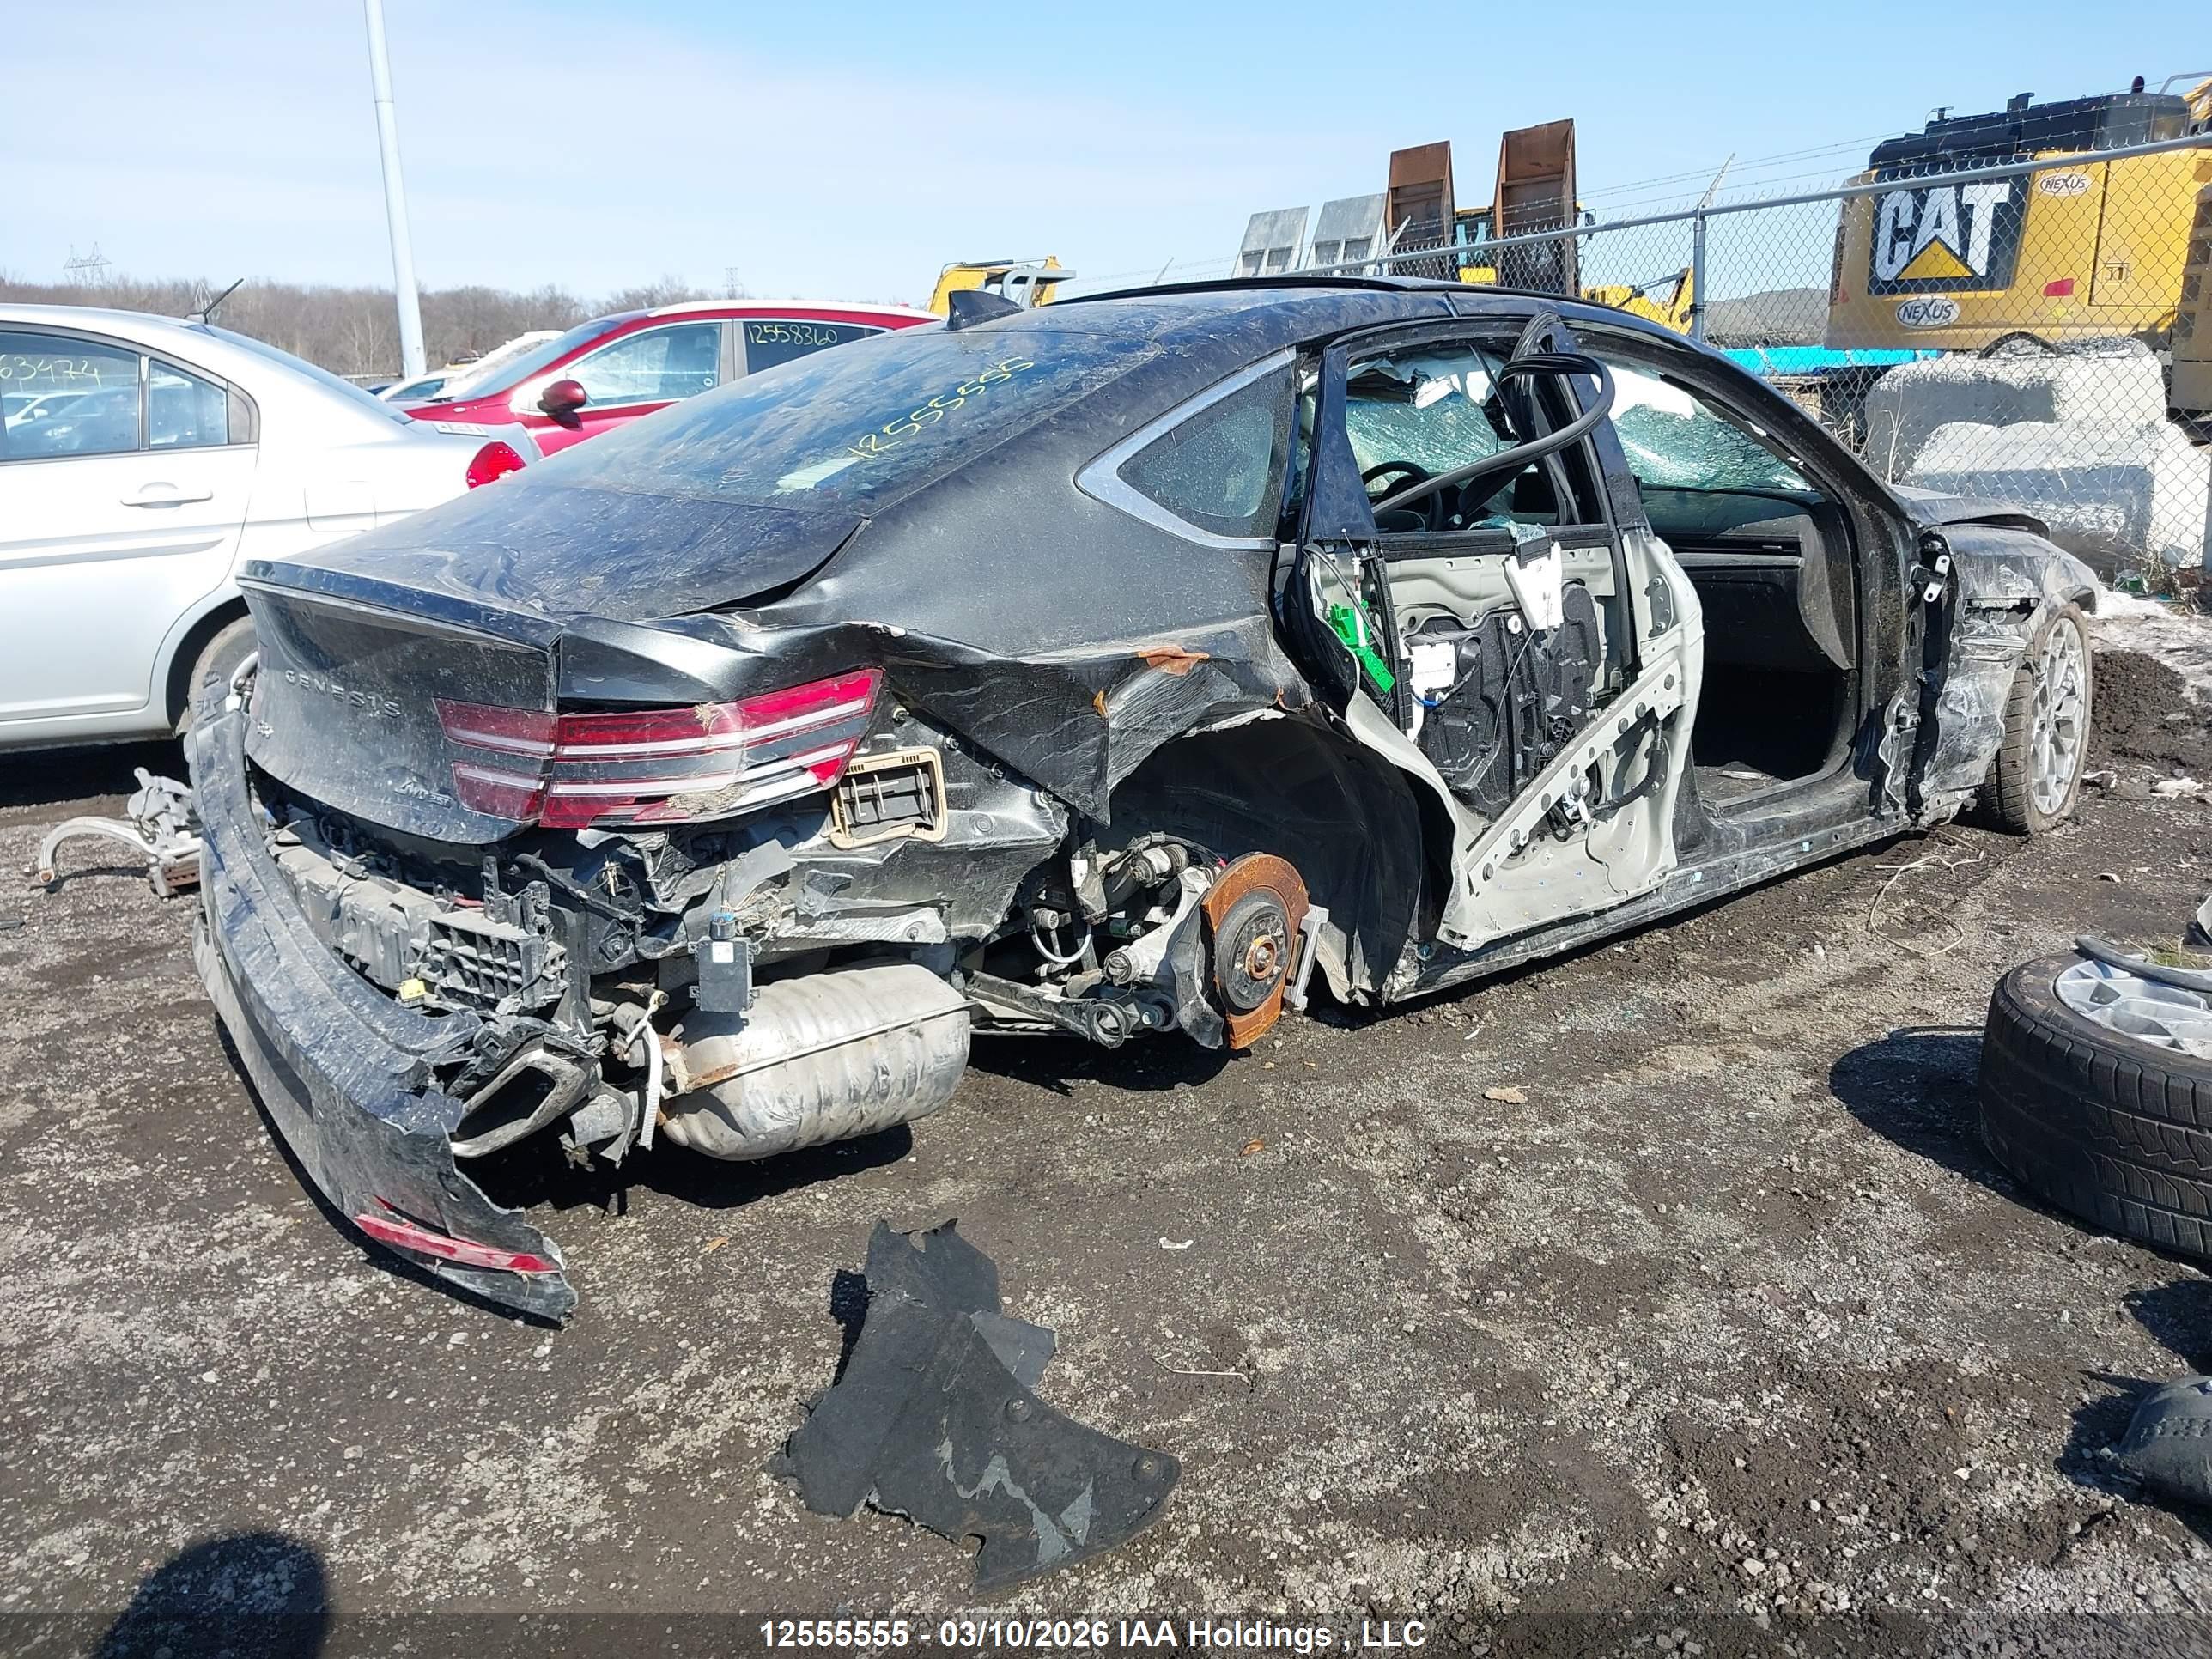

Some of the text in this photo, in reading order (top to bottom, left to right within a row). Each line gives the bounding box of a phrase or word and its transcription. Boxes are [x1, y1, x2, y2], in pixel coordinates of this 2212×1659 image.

[2045, 174, 2087, 193] NEXUS
[1875, 183, 2010, 281] CAT
[1902, 298, 1954, 325] NEXUS
[747, 324, 838, 345] 12558360
[847, 356, 1035, 459] 12555555
[285, 670, 400, 718] GENESIS
